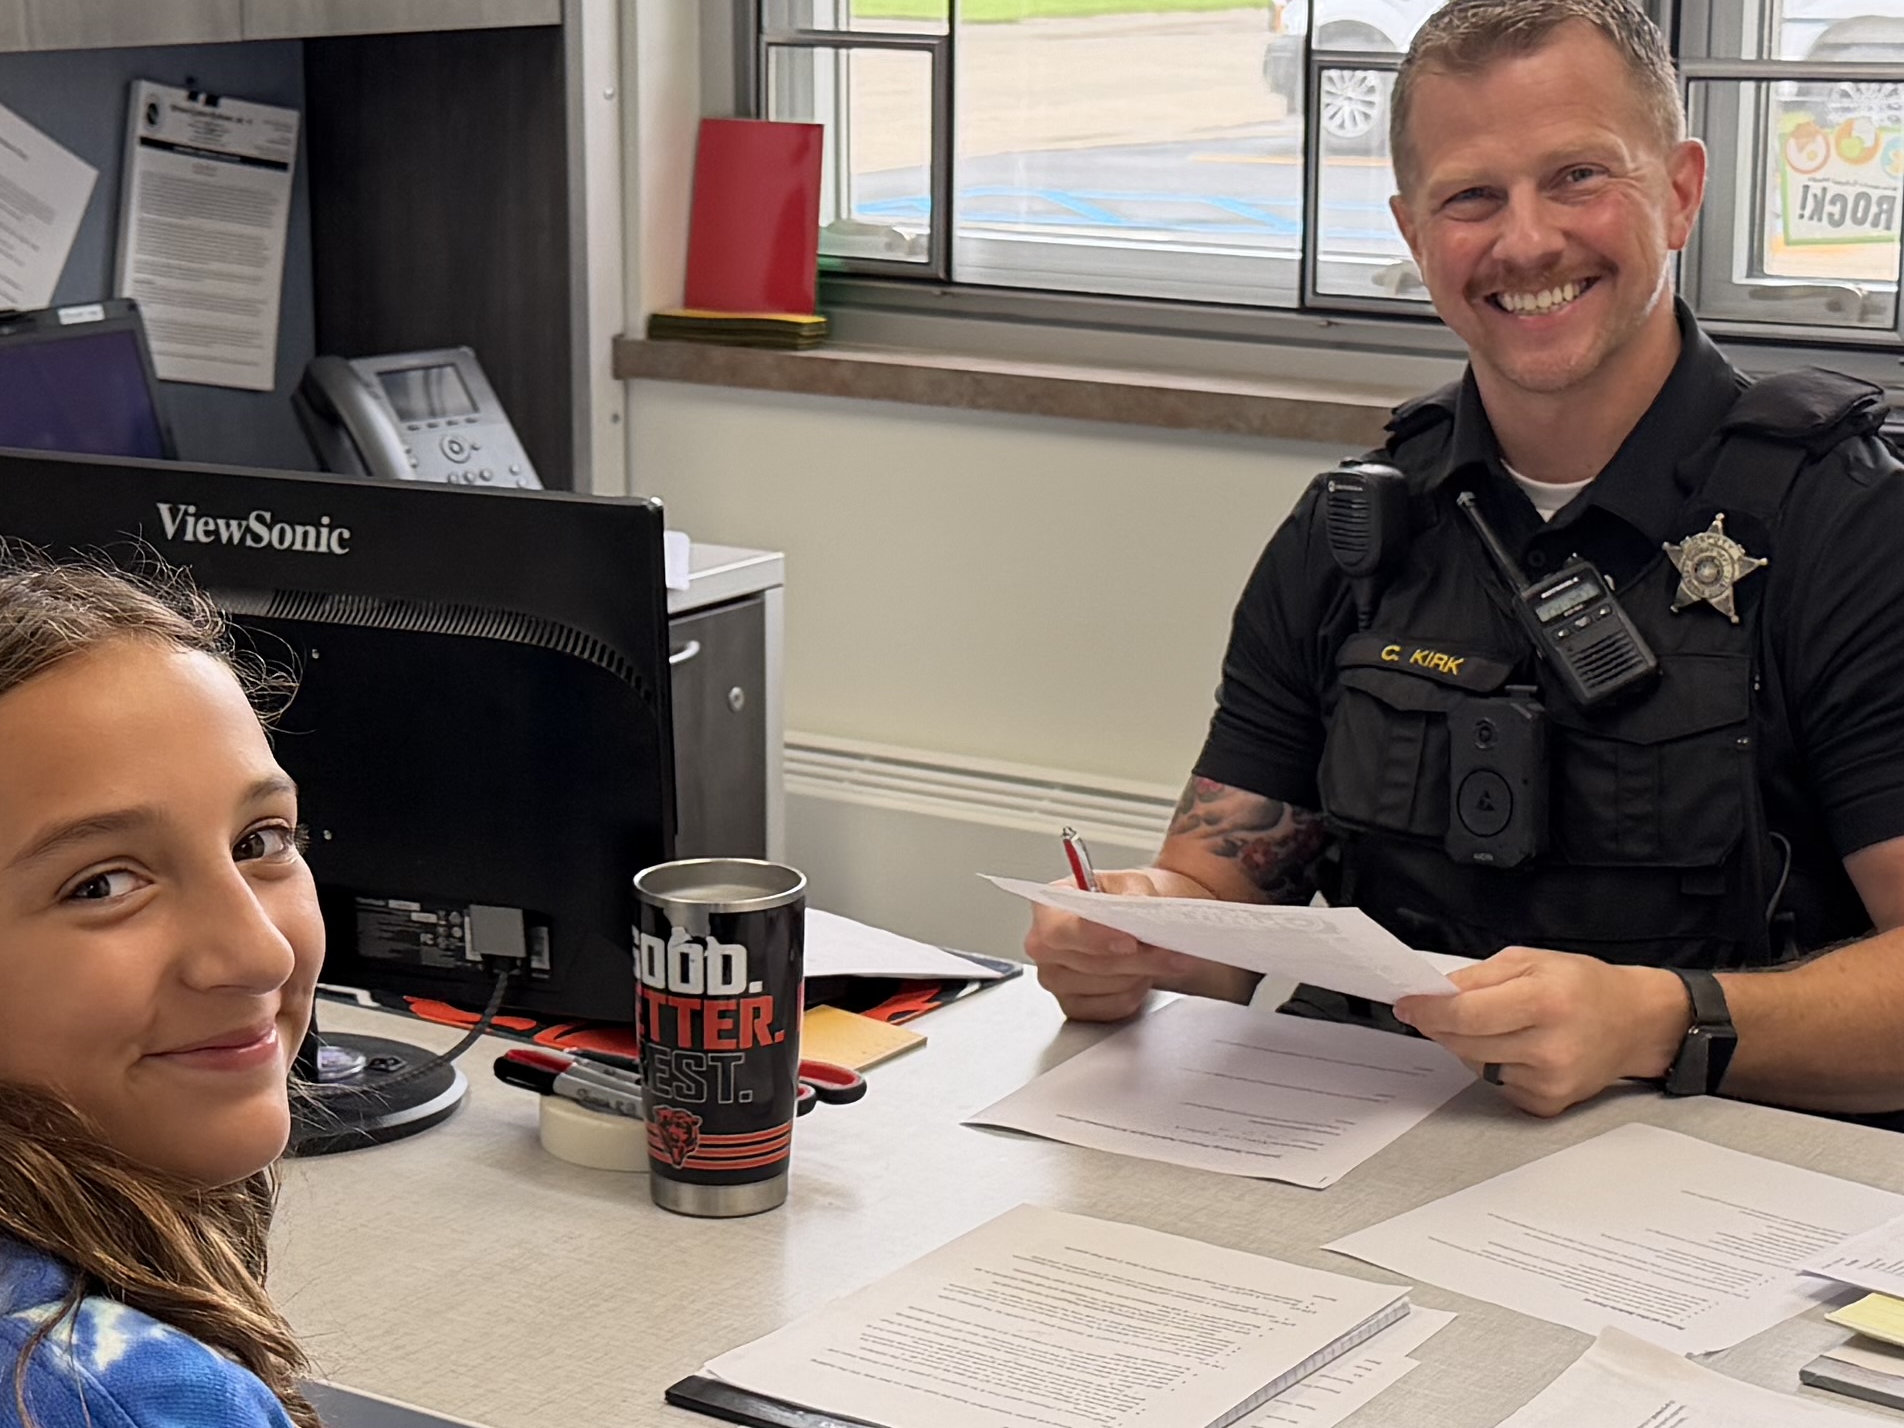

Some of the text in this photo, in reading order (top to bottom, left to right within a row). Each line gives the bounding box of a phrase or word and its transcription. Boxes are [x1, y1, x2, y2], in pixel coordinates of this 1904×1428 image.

[156, 502, 351, 555] ViewSonic
[1381, 644, 1465, 676] C. KIRK
